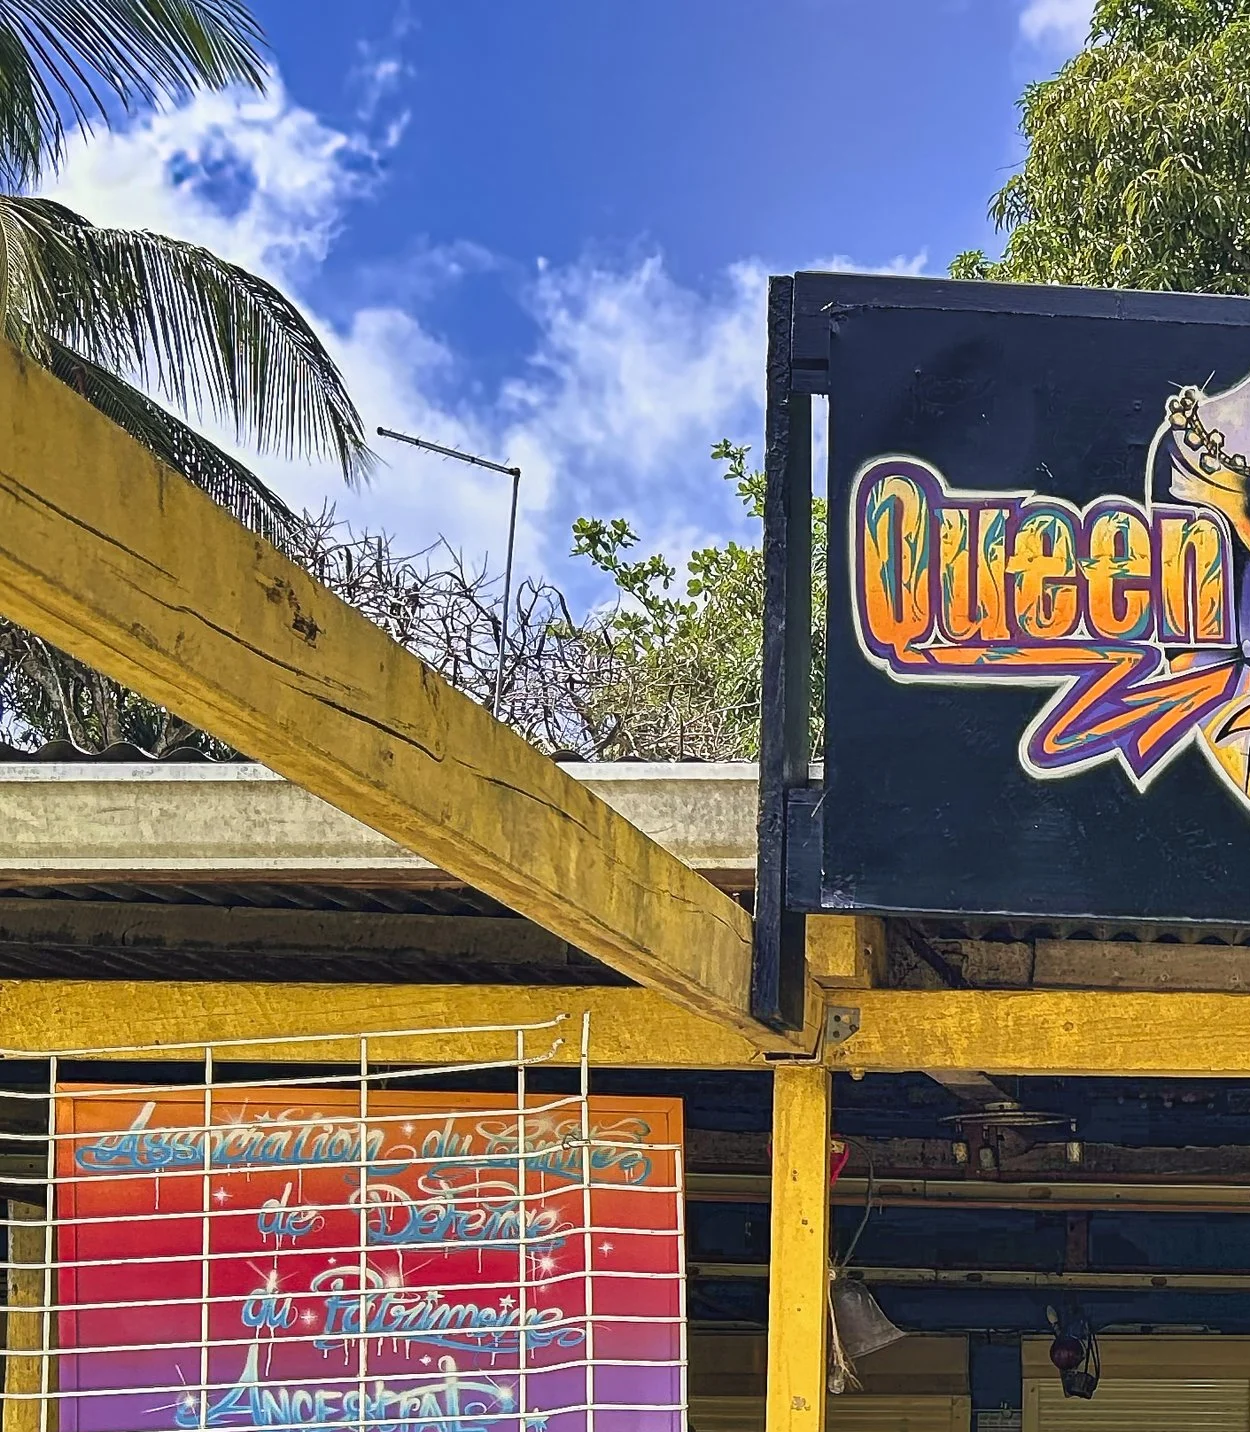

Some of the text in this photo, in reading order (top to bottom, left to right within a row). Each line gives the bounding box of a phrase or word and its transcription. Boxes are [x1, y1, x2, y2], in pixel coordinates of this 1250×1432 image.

[855, 457, 1238, 684] Queen
[76, 1101, 405, 1175] Association
[422, 1117, 473, 1160] du
[257, 1182, 325, 1236] de
[242, 1266, 585, 1353] du Patrimoine
